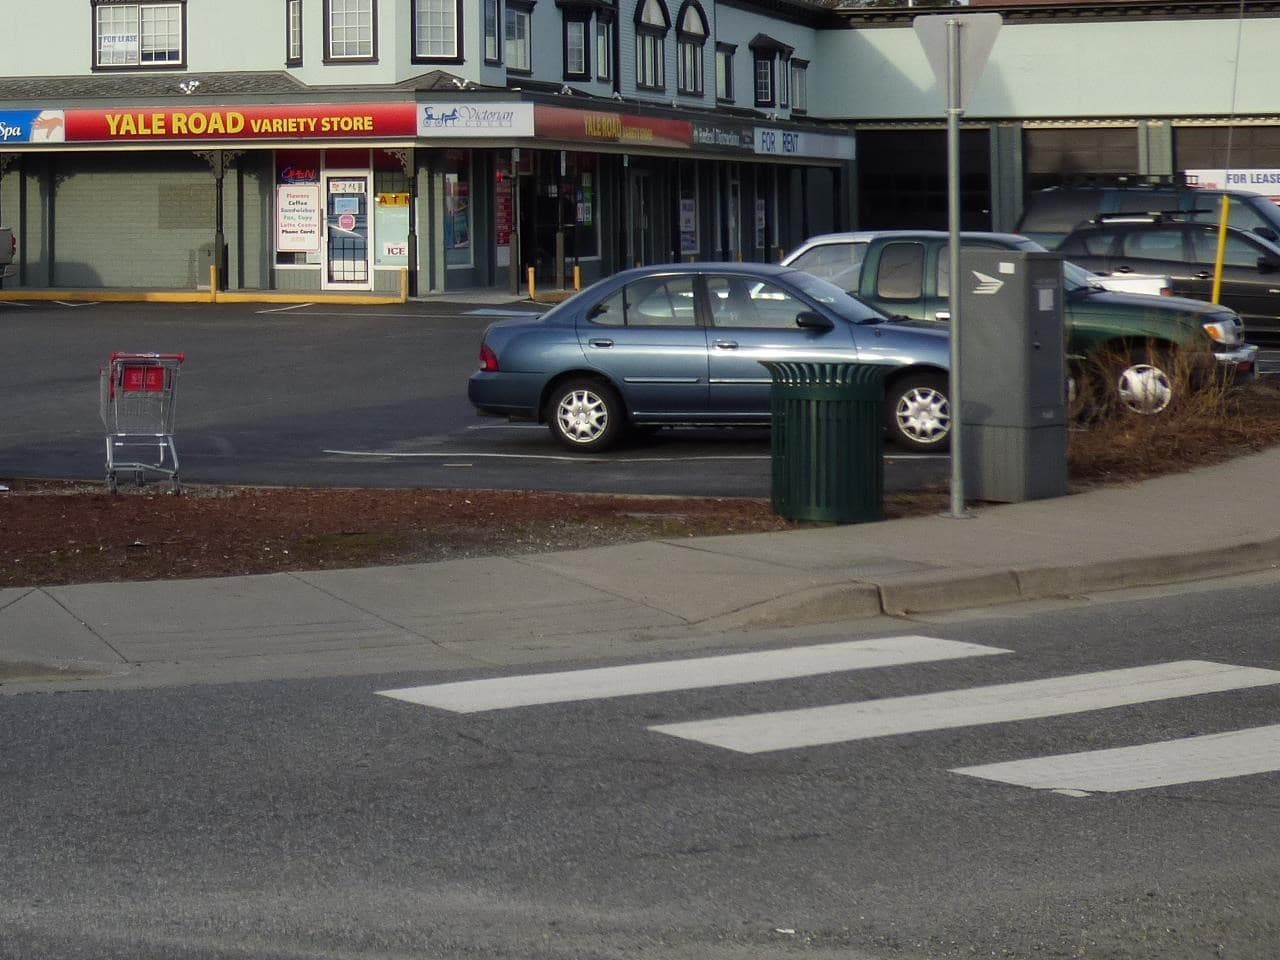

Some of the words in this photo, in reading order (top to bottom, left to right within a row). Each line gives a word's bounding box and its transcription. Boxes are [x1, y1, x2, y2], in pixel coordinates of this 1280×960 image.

[105, 113, 166, 135] YALE
[171, 112, 245, 135] ROAD
[250, 117, 318, 133] VARIETY
[321, 116, 374, 132] STORE
[762, 131, 776, 152] FOR
[782, 132, 799, 153] RENT
[1226, 173, 1247, 184] FOR
[1250, 173, 1280, 185] LEASE
[387, 247, 405, 256] ICE
